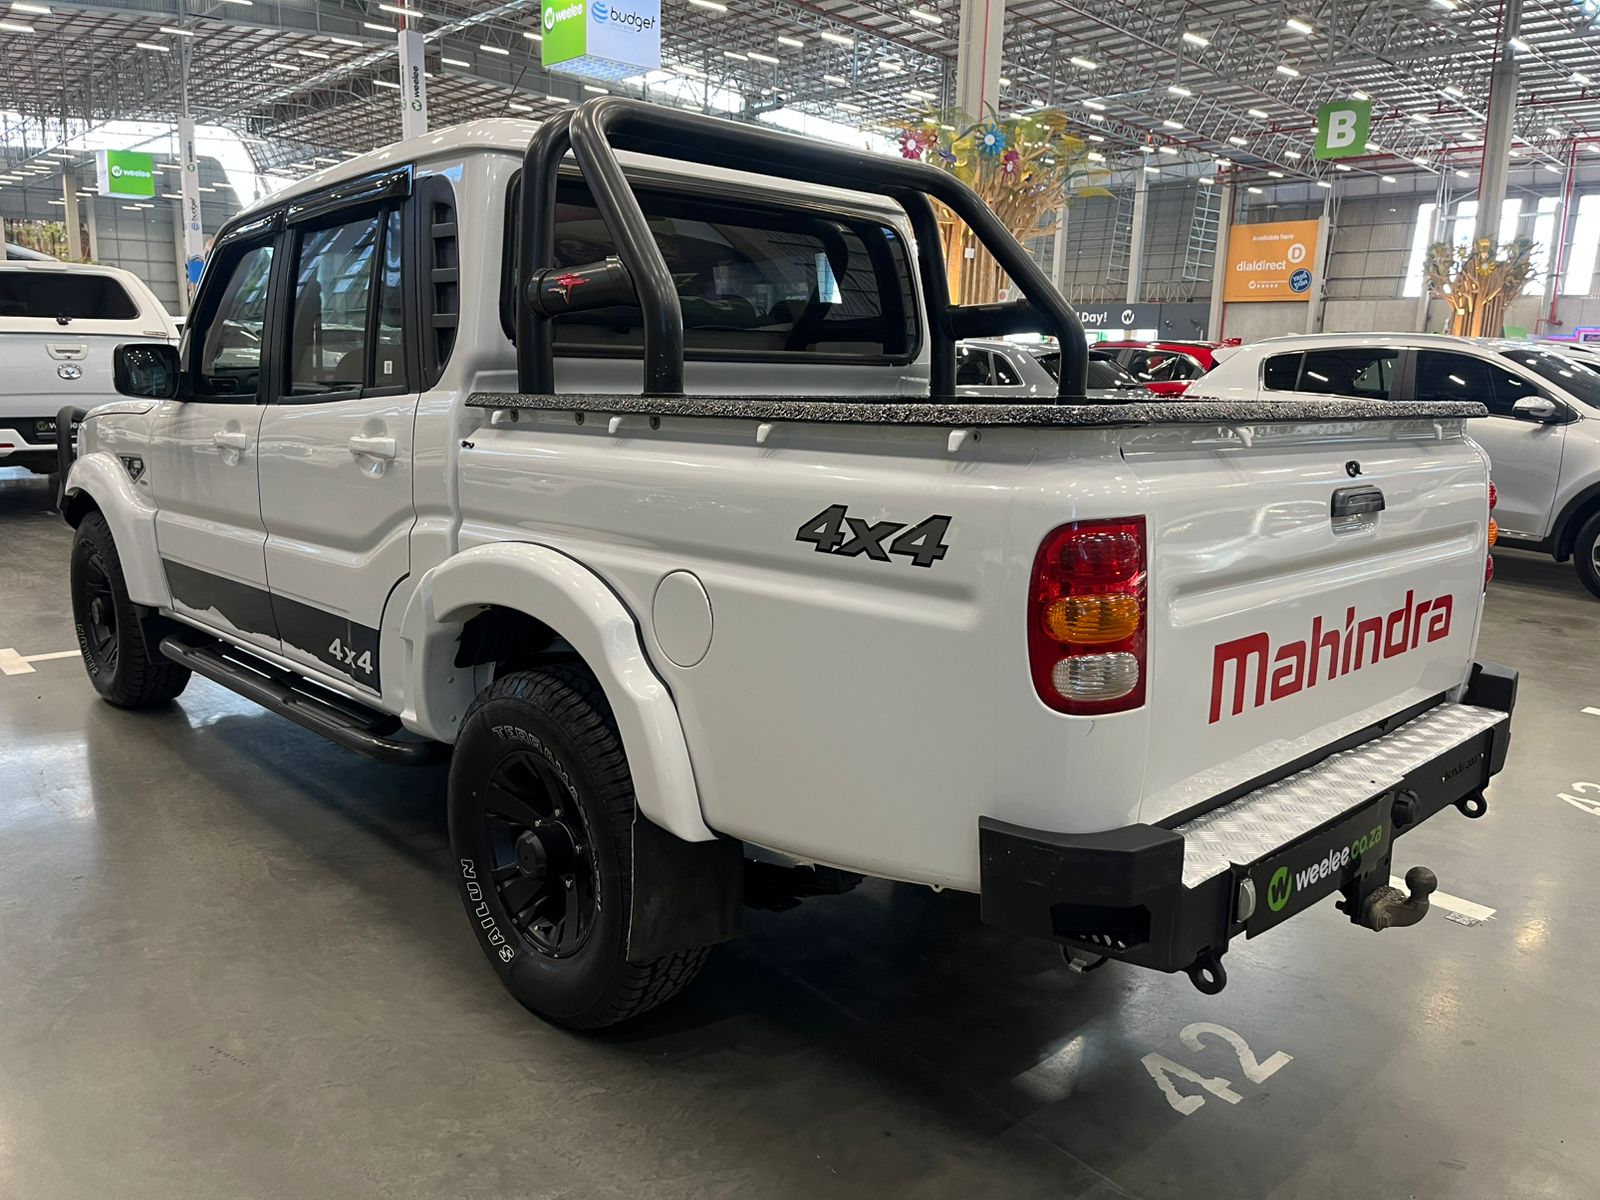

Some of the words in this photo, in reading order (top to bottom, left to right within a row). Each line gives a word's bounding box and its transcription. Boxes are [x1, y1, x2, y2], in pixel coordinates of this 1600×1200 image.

[555, 3, 583, 22] weelee
[610, 6, 656, 32] budget
[1327, 110, 1357, 149] B
[123, 169, 151, 178] weelee
[1252, 233, 1280, 241] Available
[1280, 232, 1294, 240] here
[1236, 260, 1286, 272] dialdirect
[1082, 312, 1107, 325] Day!
[795, 503, 952, 568] 4x4
[328, 637, 374, 675] 4x4
[1208, 589, 1453, 724] Mahindra
[1295, 824, 1383, 891] weelee.co.za
[460, 858, 515, 963] SAILUN
[1140, 1022, 1294, 1116] 42
